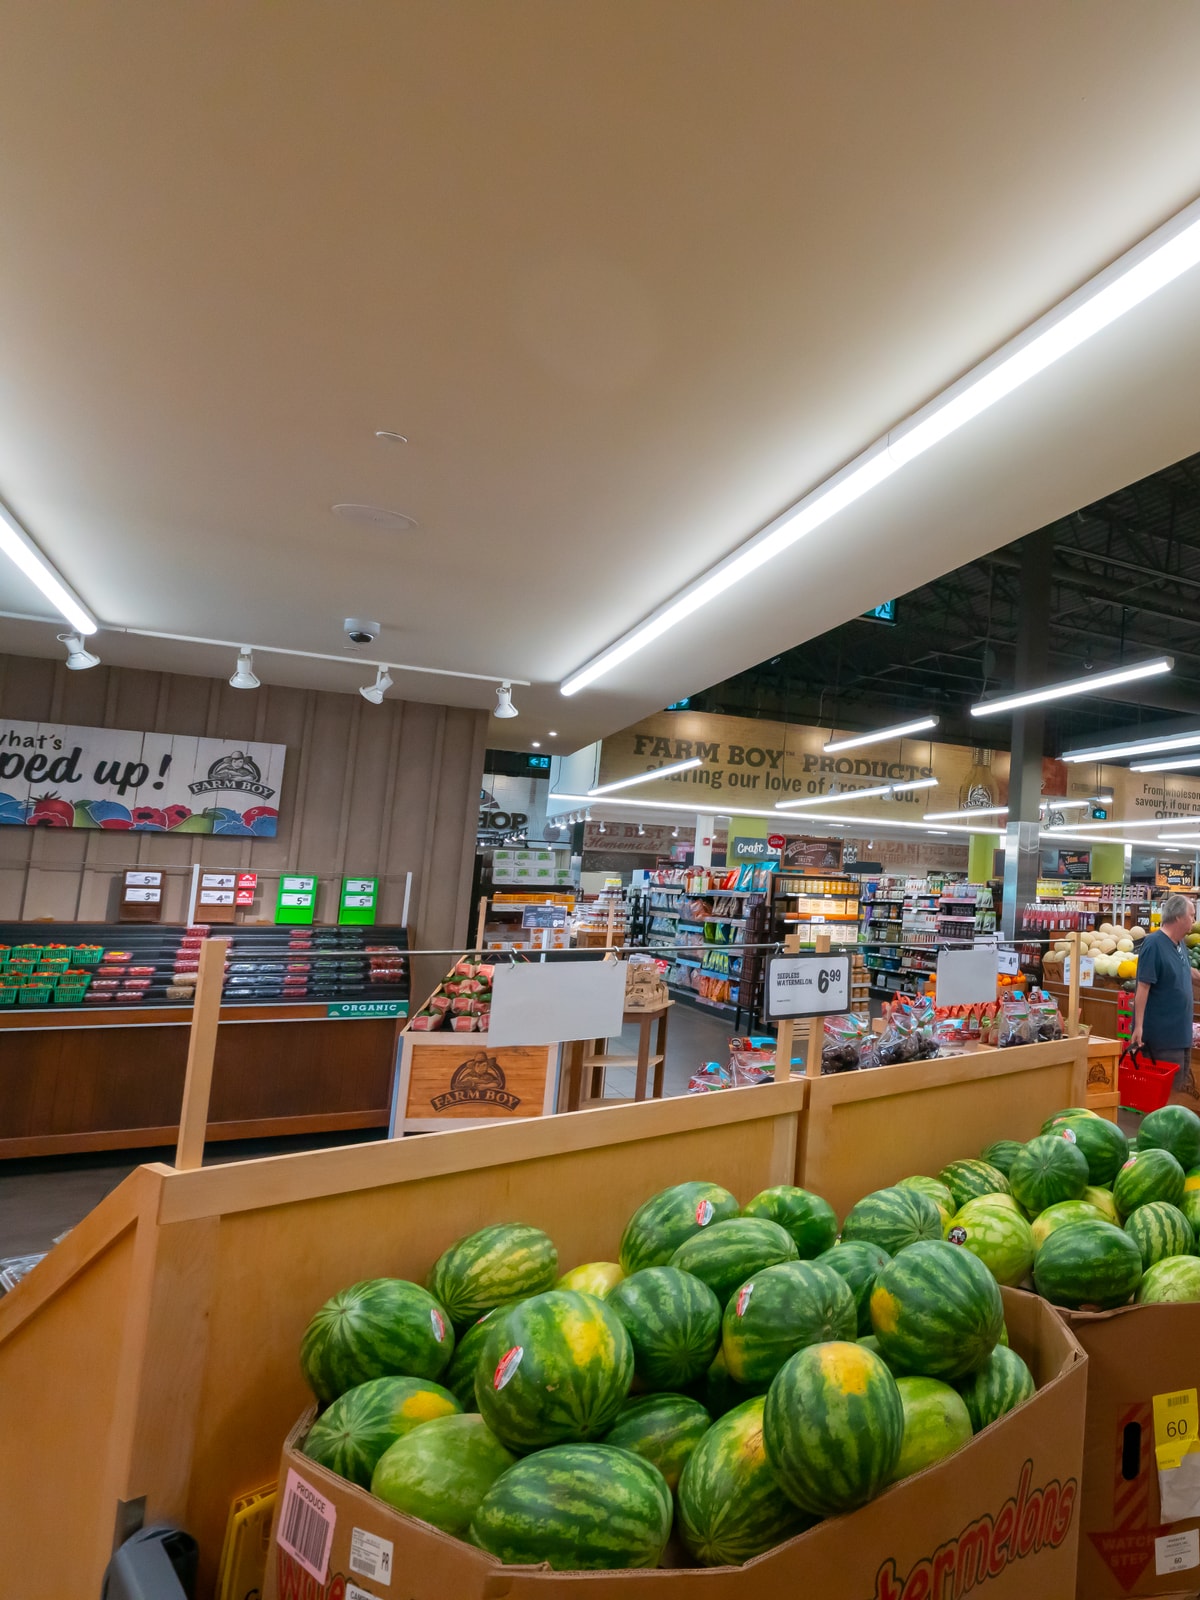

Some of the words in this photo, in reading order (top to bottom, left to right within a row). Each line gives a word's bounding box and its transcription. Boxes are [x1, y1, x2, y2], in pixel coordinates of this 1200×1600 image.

[633, 735, 721, 763] FARM
[727, 745, 785, 769] BOY
[802, 754, 934, 782] PRODUCTS
[94, 754, 172, 796] up!
[728, 772, 760, 788] our
[765, 771, 801, 790] love
[807, 777, 825, 794] of
[190, 780, 237, 793] FARM
[241, 781, 272, 796] BOY
[1143, 784, 1163, 795] From
[1135, 798, 1168, 810] savoury,
[737, 843, 764, 854] Craft
[777, 972, 800, 980] SEEDLESS
[777, 978, 813, 987] WATERMELON
[434, 1090, 480, 1108] FARM
[485, 1091, 518, 1107] BOY
[1166, 1419, 1188, 1438] 60
[297, 1481, 326, 1514] PRODUCE
